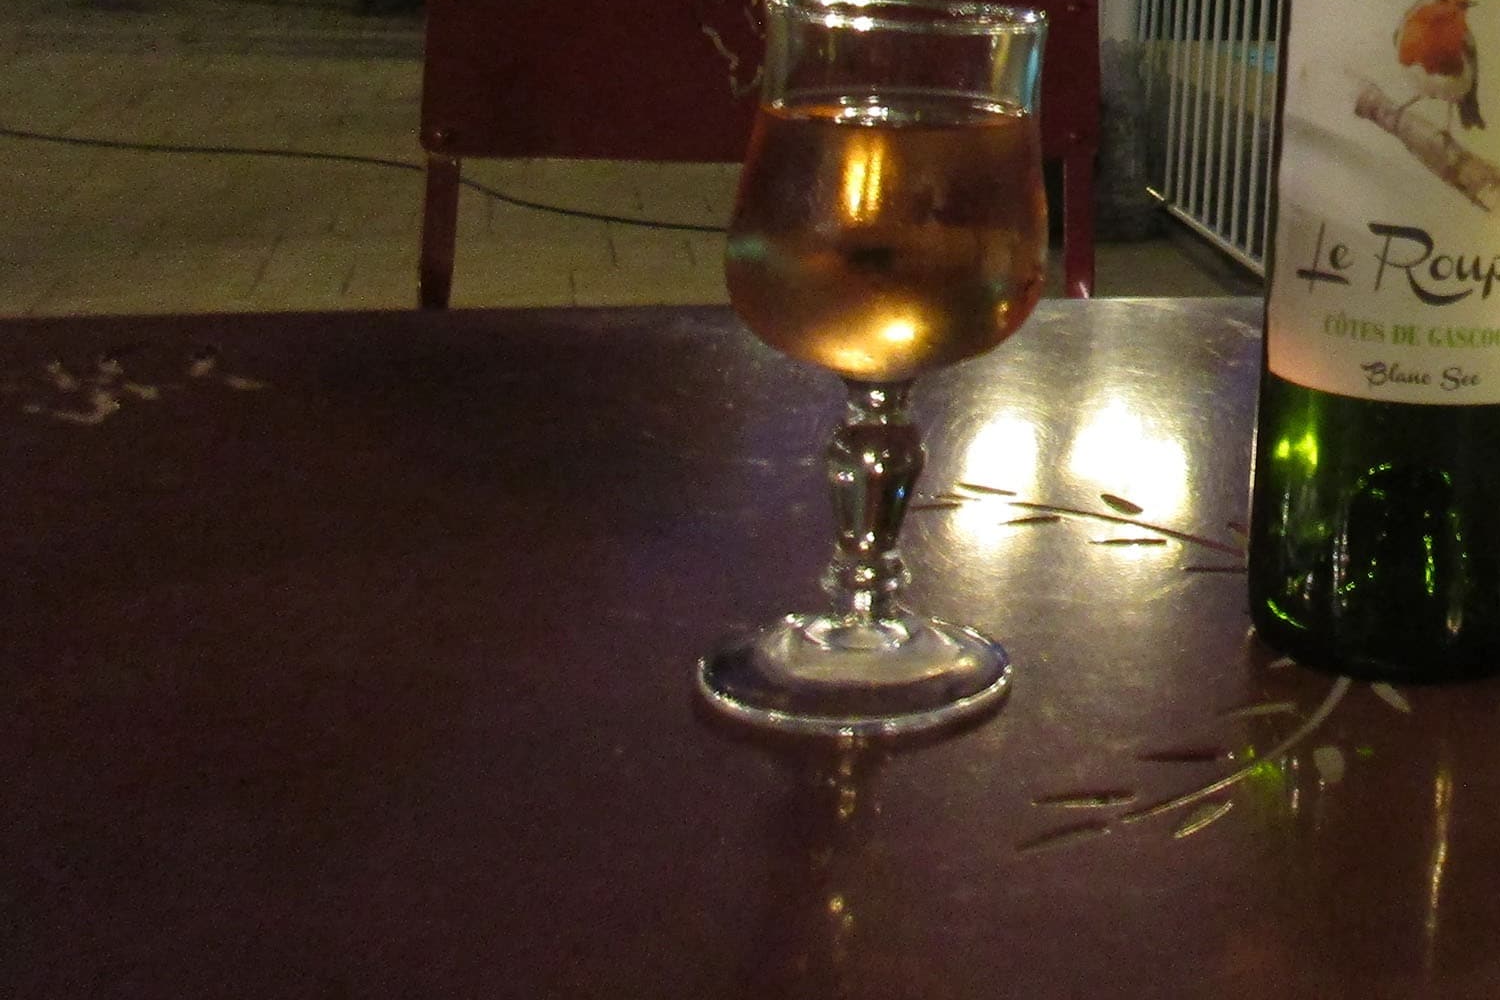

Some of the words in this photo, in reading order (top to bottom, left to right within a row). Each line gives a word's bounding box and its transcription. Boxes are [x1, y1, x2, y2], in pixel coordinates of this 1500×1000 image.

[1295, 221, 1354, 294] Le
[1323, 311, 1385, 344] CÔTES
[1391, 323, 1419, 346] DE
[1360, 360, 1432, 388] Blanc
[1439, 366, 1482, 392] Sec
